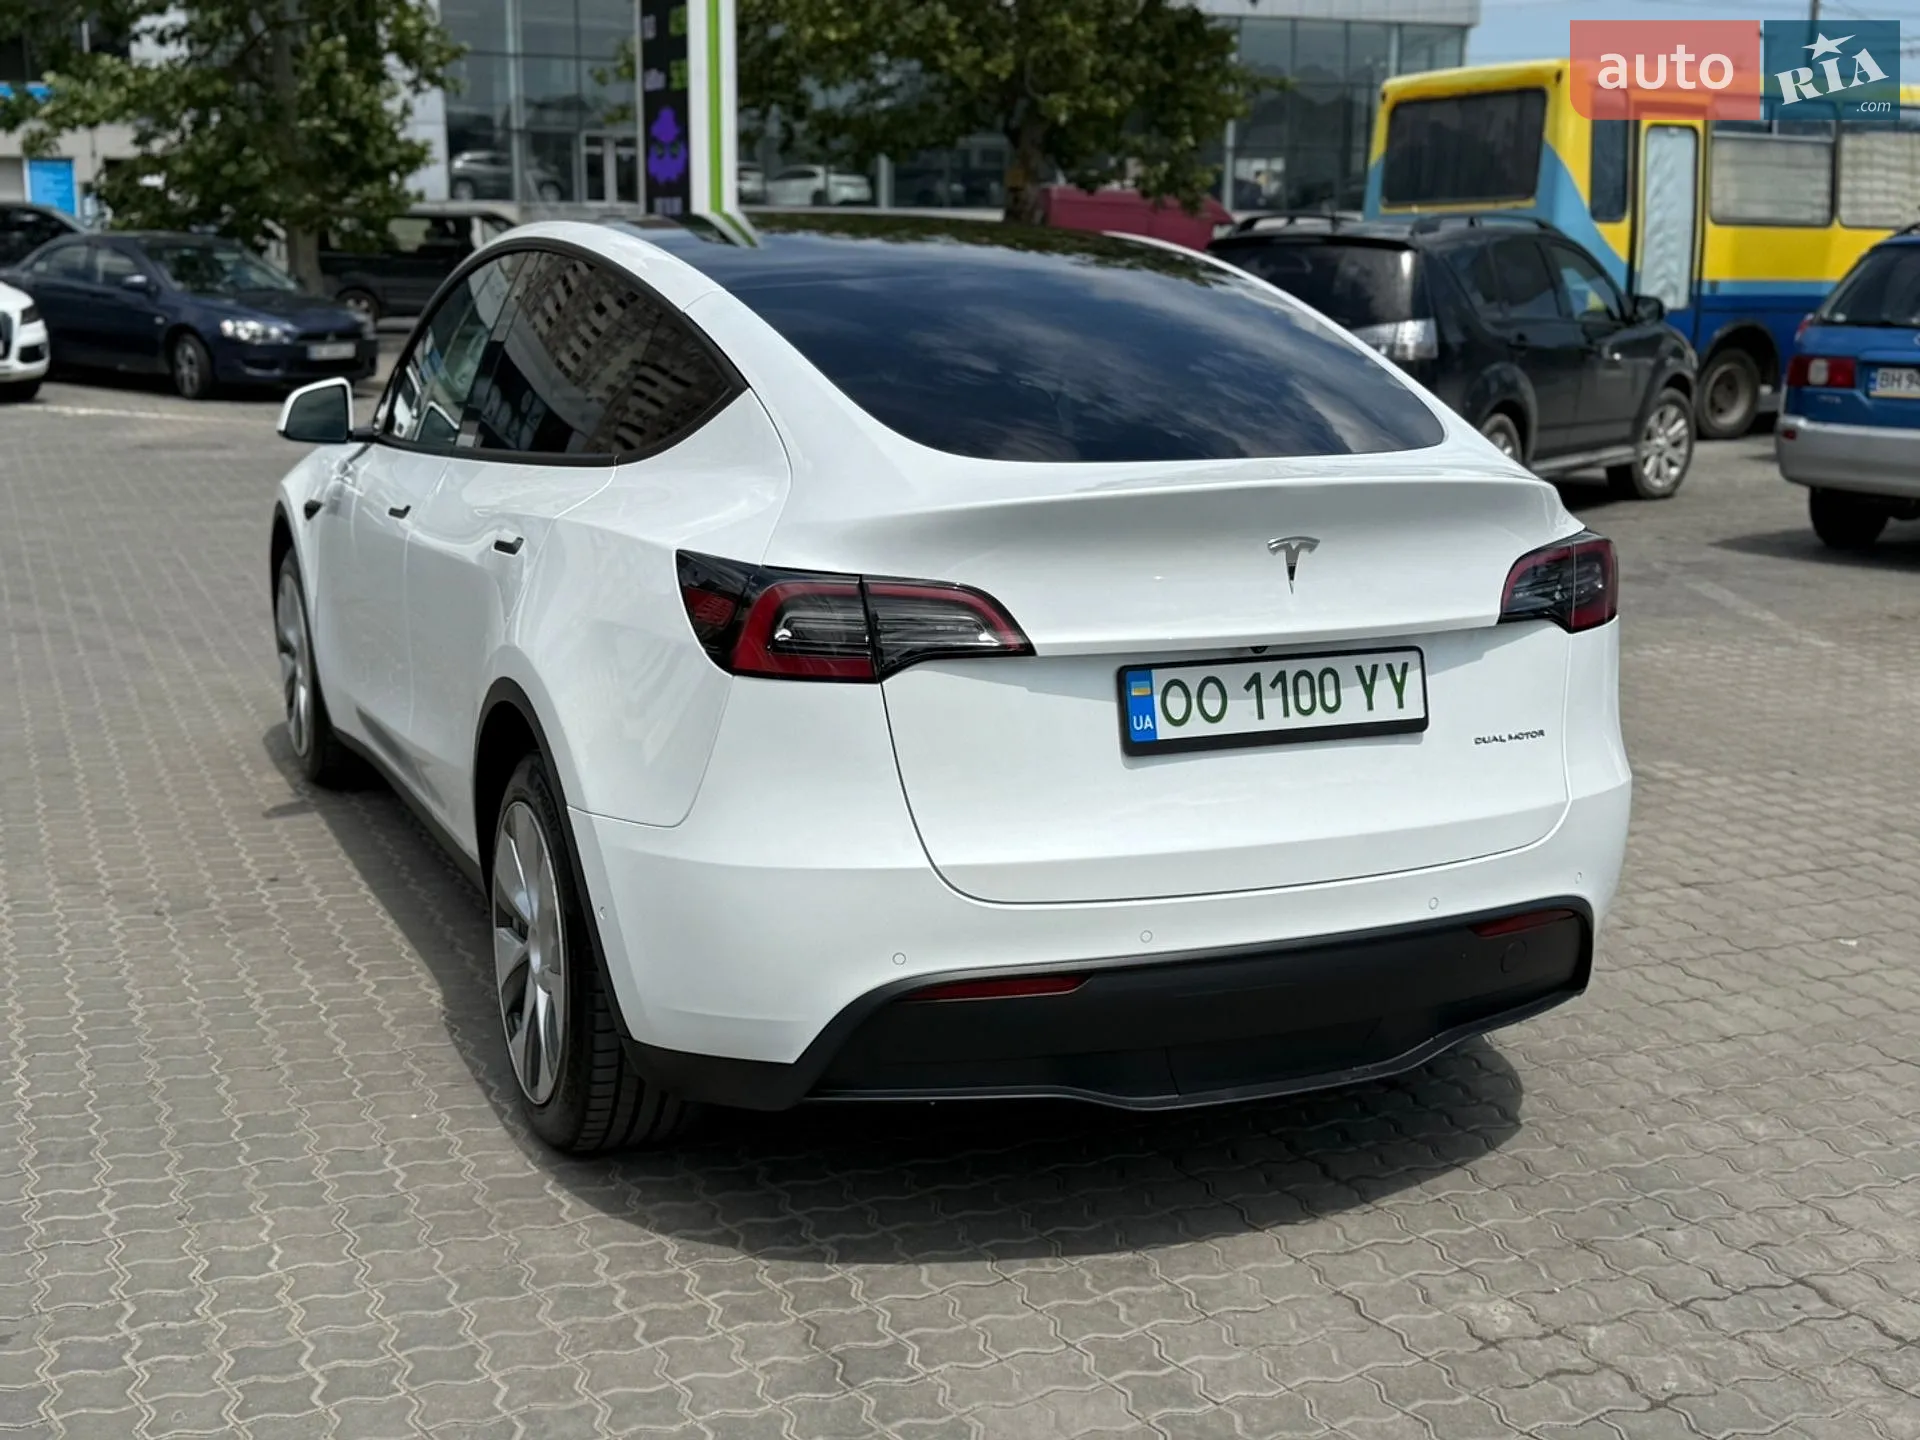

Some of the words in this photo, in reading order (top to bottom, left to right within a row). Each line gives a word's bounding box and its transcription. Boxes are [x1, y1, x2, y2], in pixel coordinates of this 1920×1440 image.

[1160, 675, 1228, 727] OO
[1243, 666, 1342, 720] 1100
[1355, 661, 1409, 711] YY
[1132, 714, 1154, 731] UA
[1474, 735, 1506, 745] DUAL
[1508, 729, 1545, 741] MOTOR
